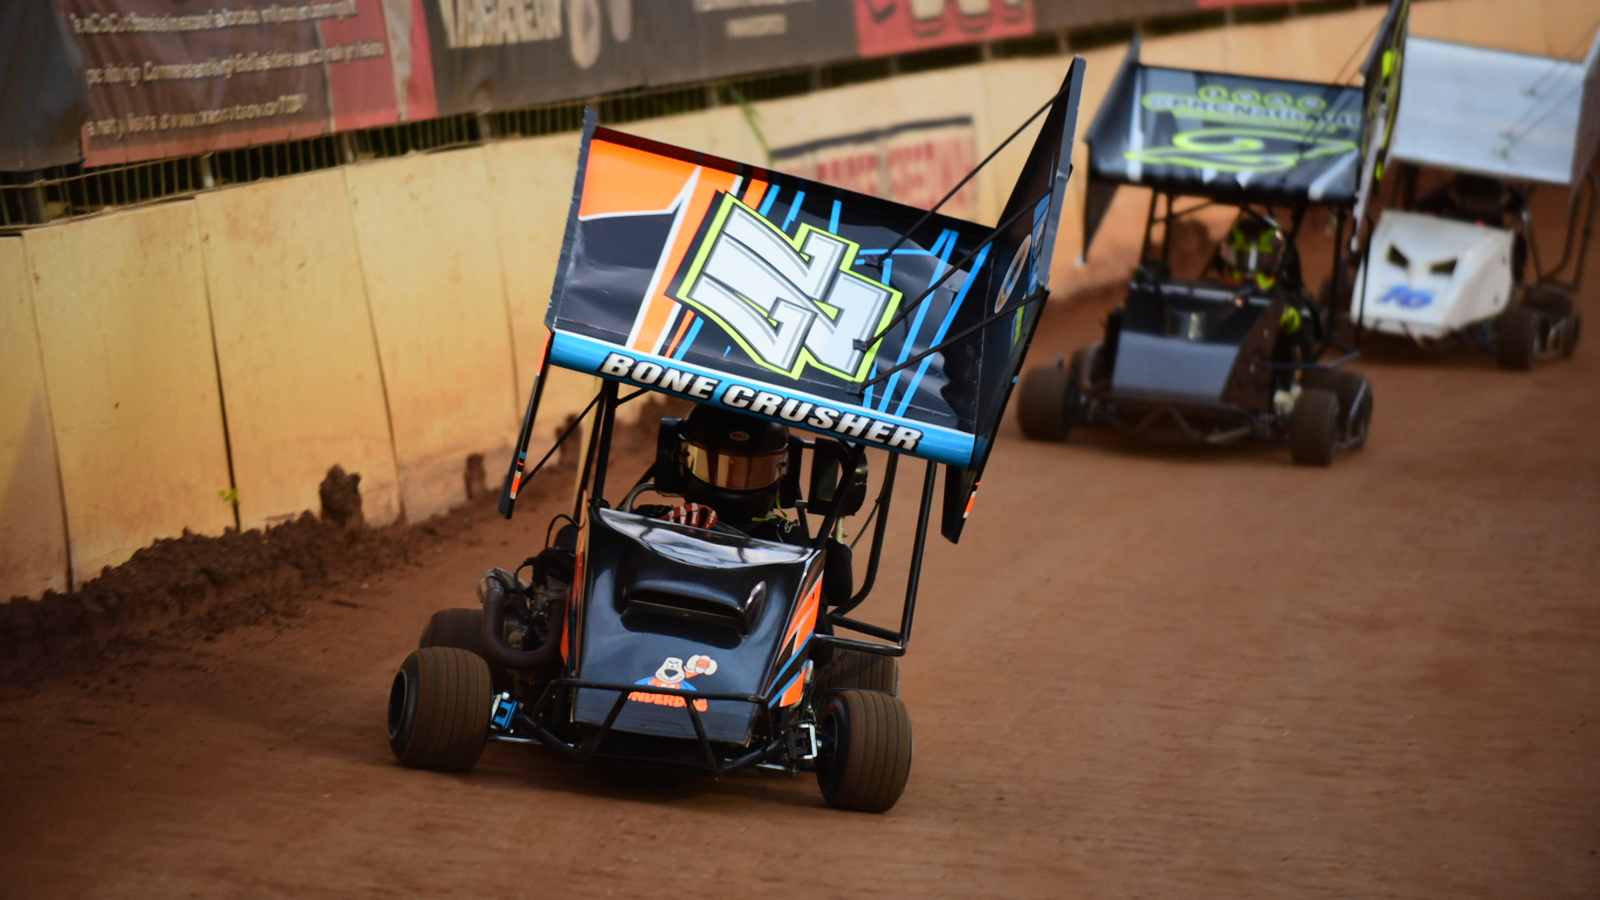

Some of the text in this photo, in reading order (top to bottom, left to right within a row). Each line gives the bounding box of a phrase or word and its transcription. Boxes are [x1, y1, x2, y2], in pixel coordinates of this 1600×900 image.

[600, 351, 923, 451] BONE CRUSHER
[627, 691, 708, 712] NDERDG
